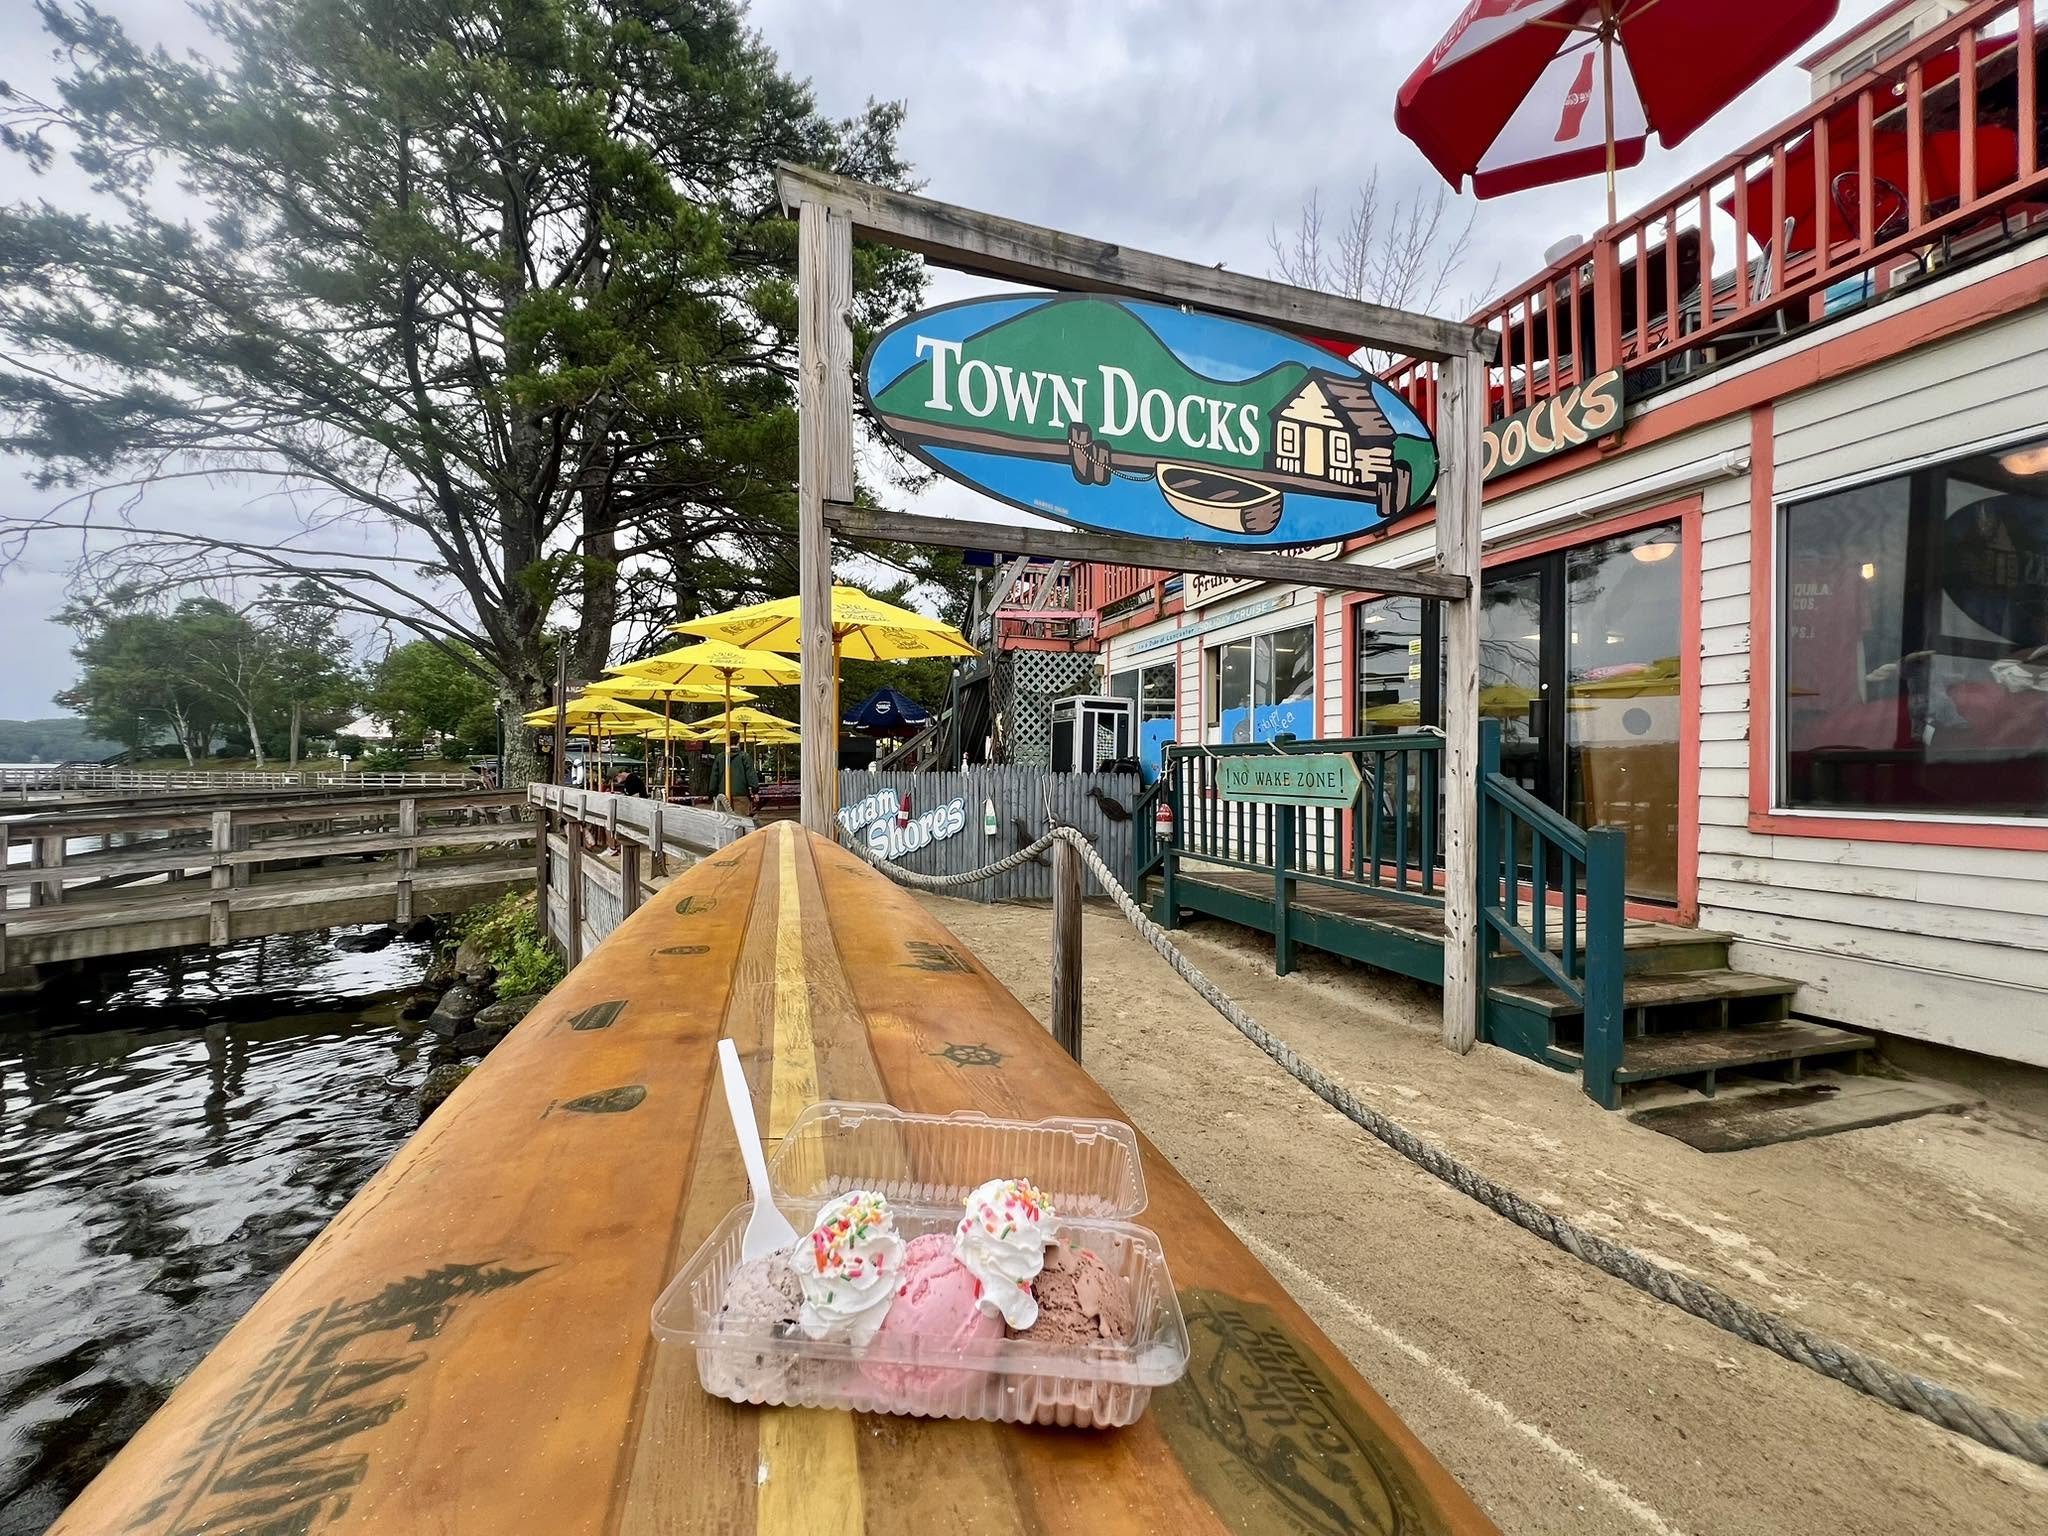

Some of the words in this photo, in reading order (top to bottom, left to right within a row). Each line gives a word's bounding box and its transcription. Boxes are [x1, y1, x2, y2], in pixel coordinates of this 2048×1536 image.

[915, 335, 1088, 429] TOWN
[1098, 364, 1260, 456] DOCKS
[1255, 771, 1291, 787] WAKE
[869, 798, 965, 860] Shores
